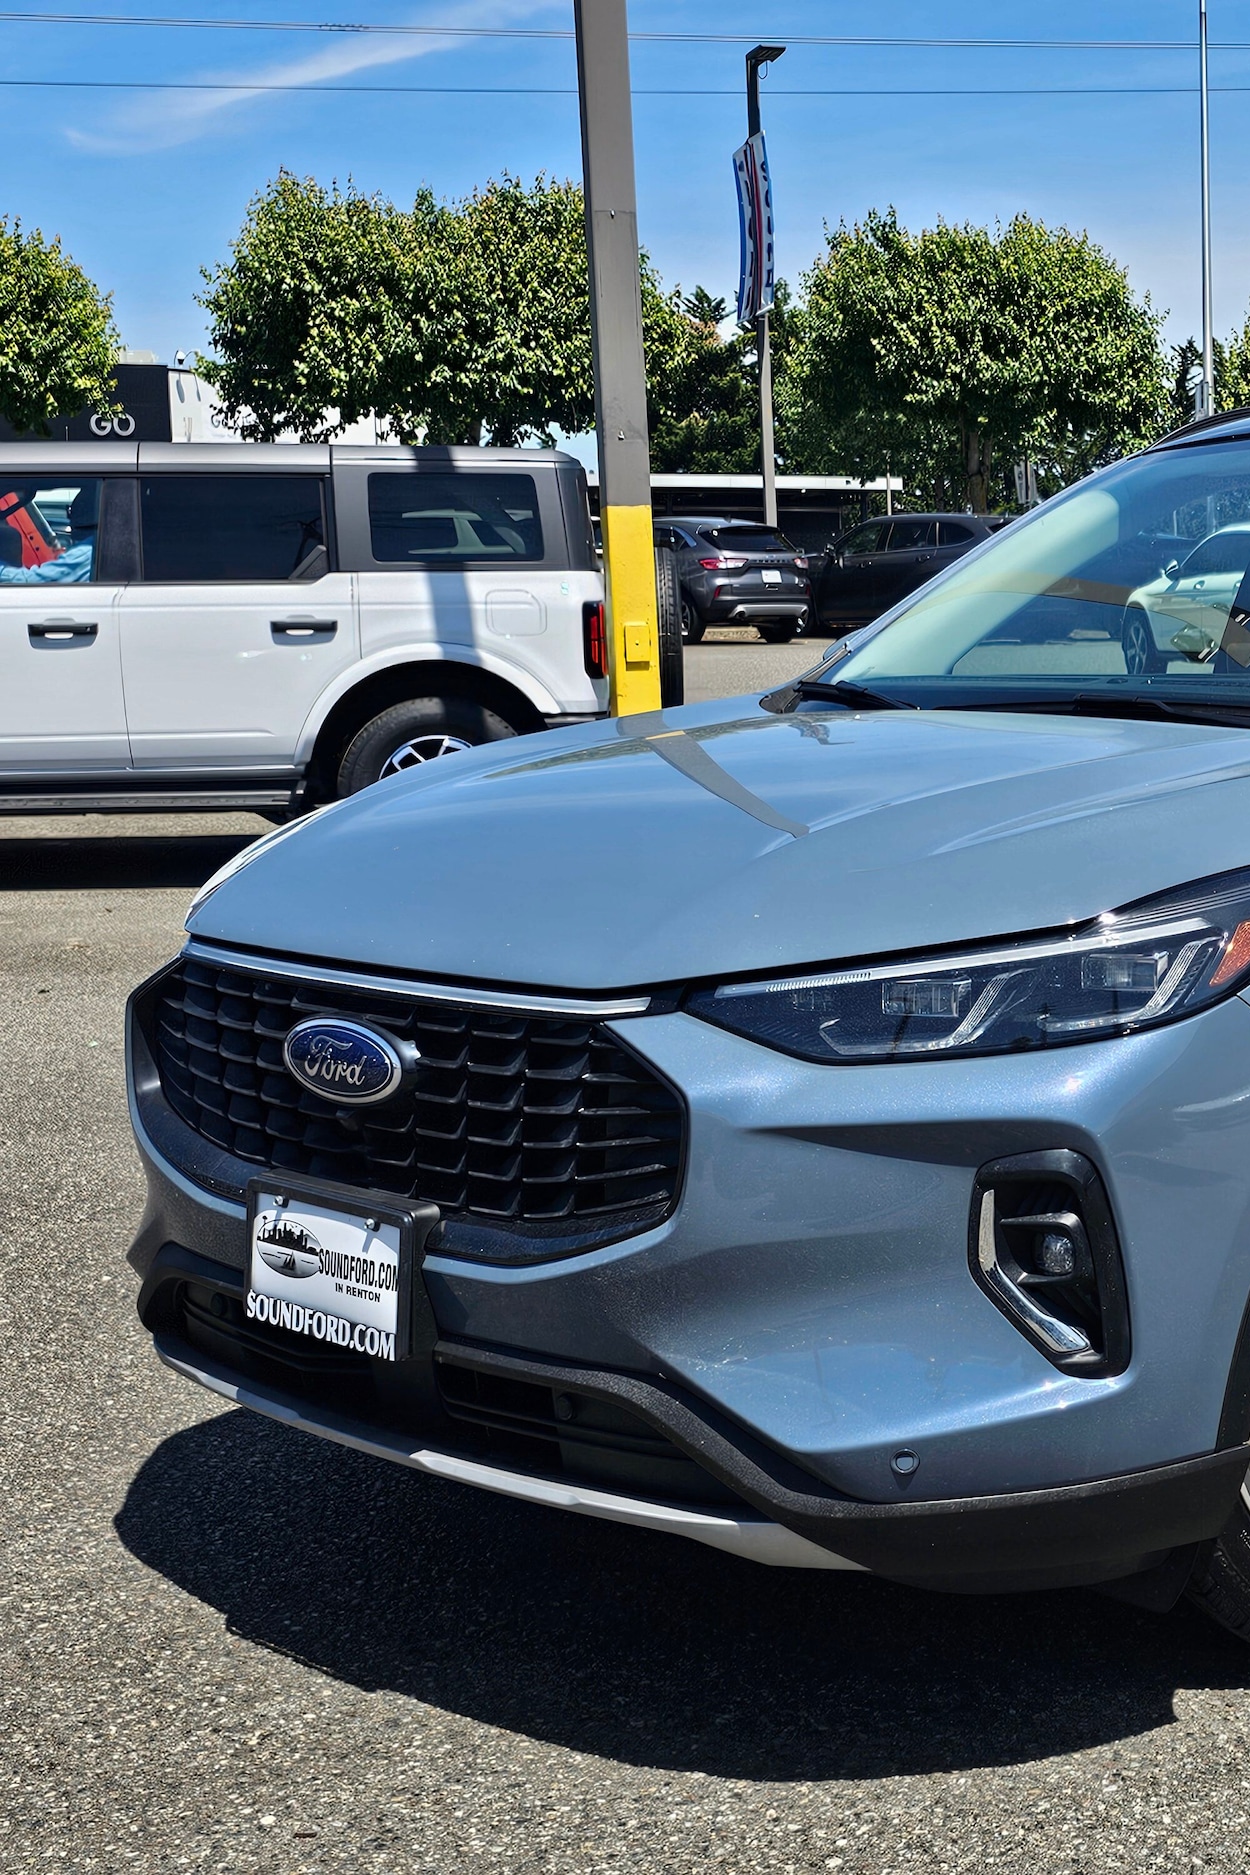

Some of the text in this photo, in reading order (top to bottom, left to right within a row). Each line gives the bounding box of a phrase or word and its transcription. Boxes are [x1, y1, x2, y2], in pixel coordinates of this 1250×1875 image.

[89, 412, 136, 437] GO
[304, 1035, 366, 1086] Ford
[335, 1282, 381, 1303] IN RENTON
[246, 1288, 396, 1362] SOUNDFORD.COM
